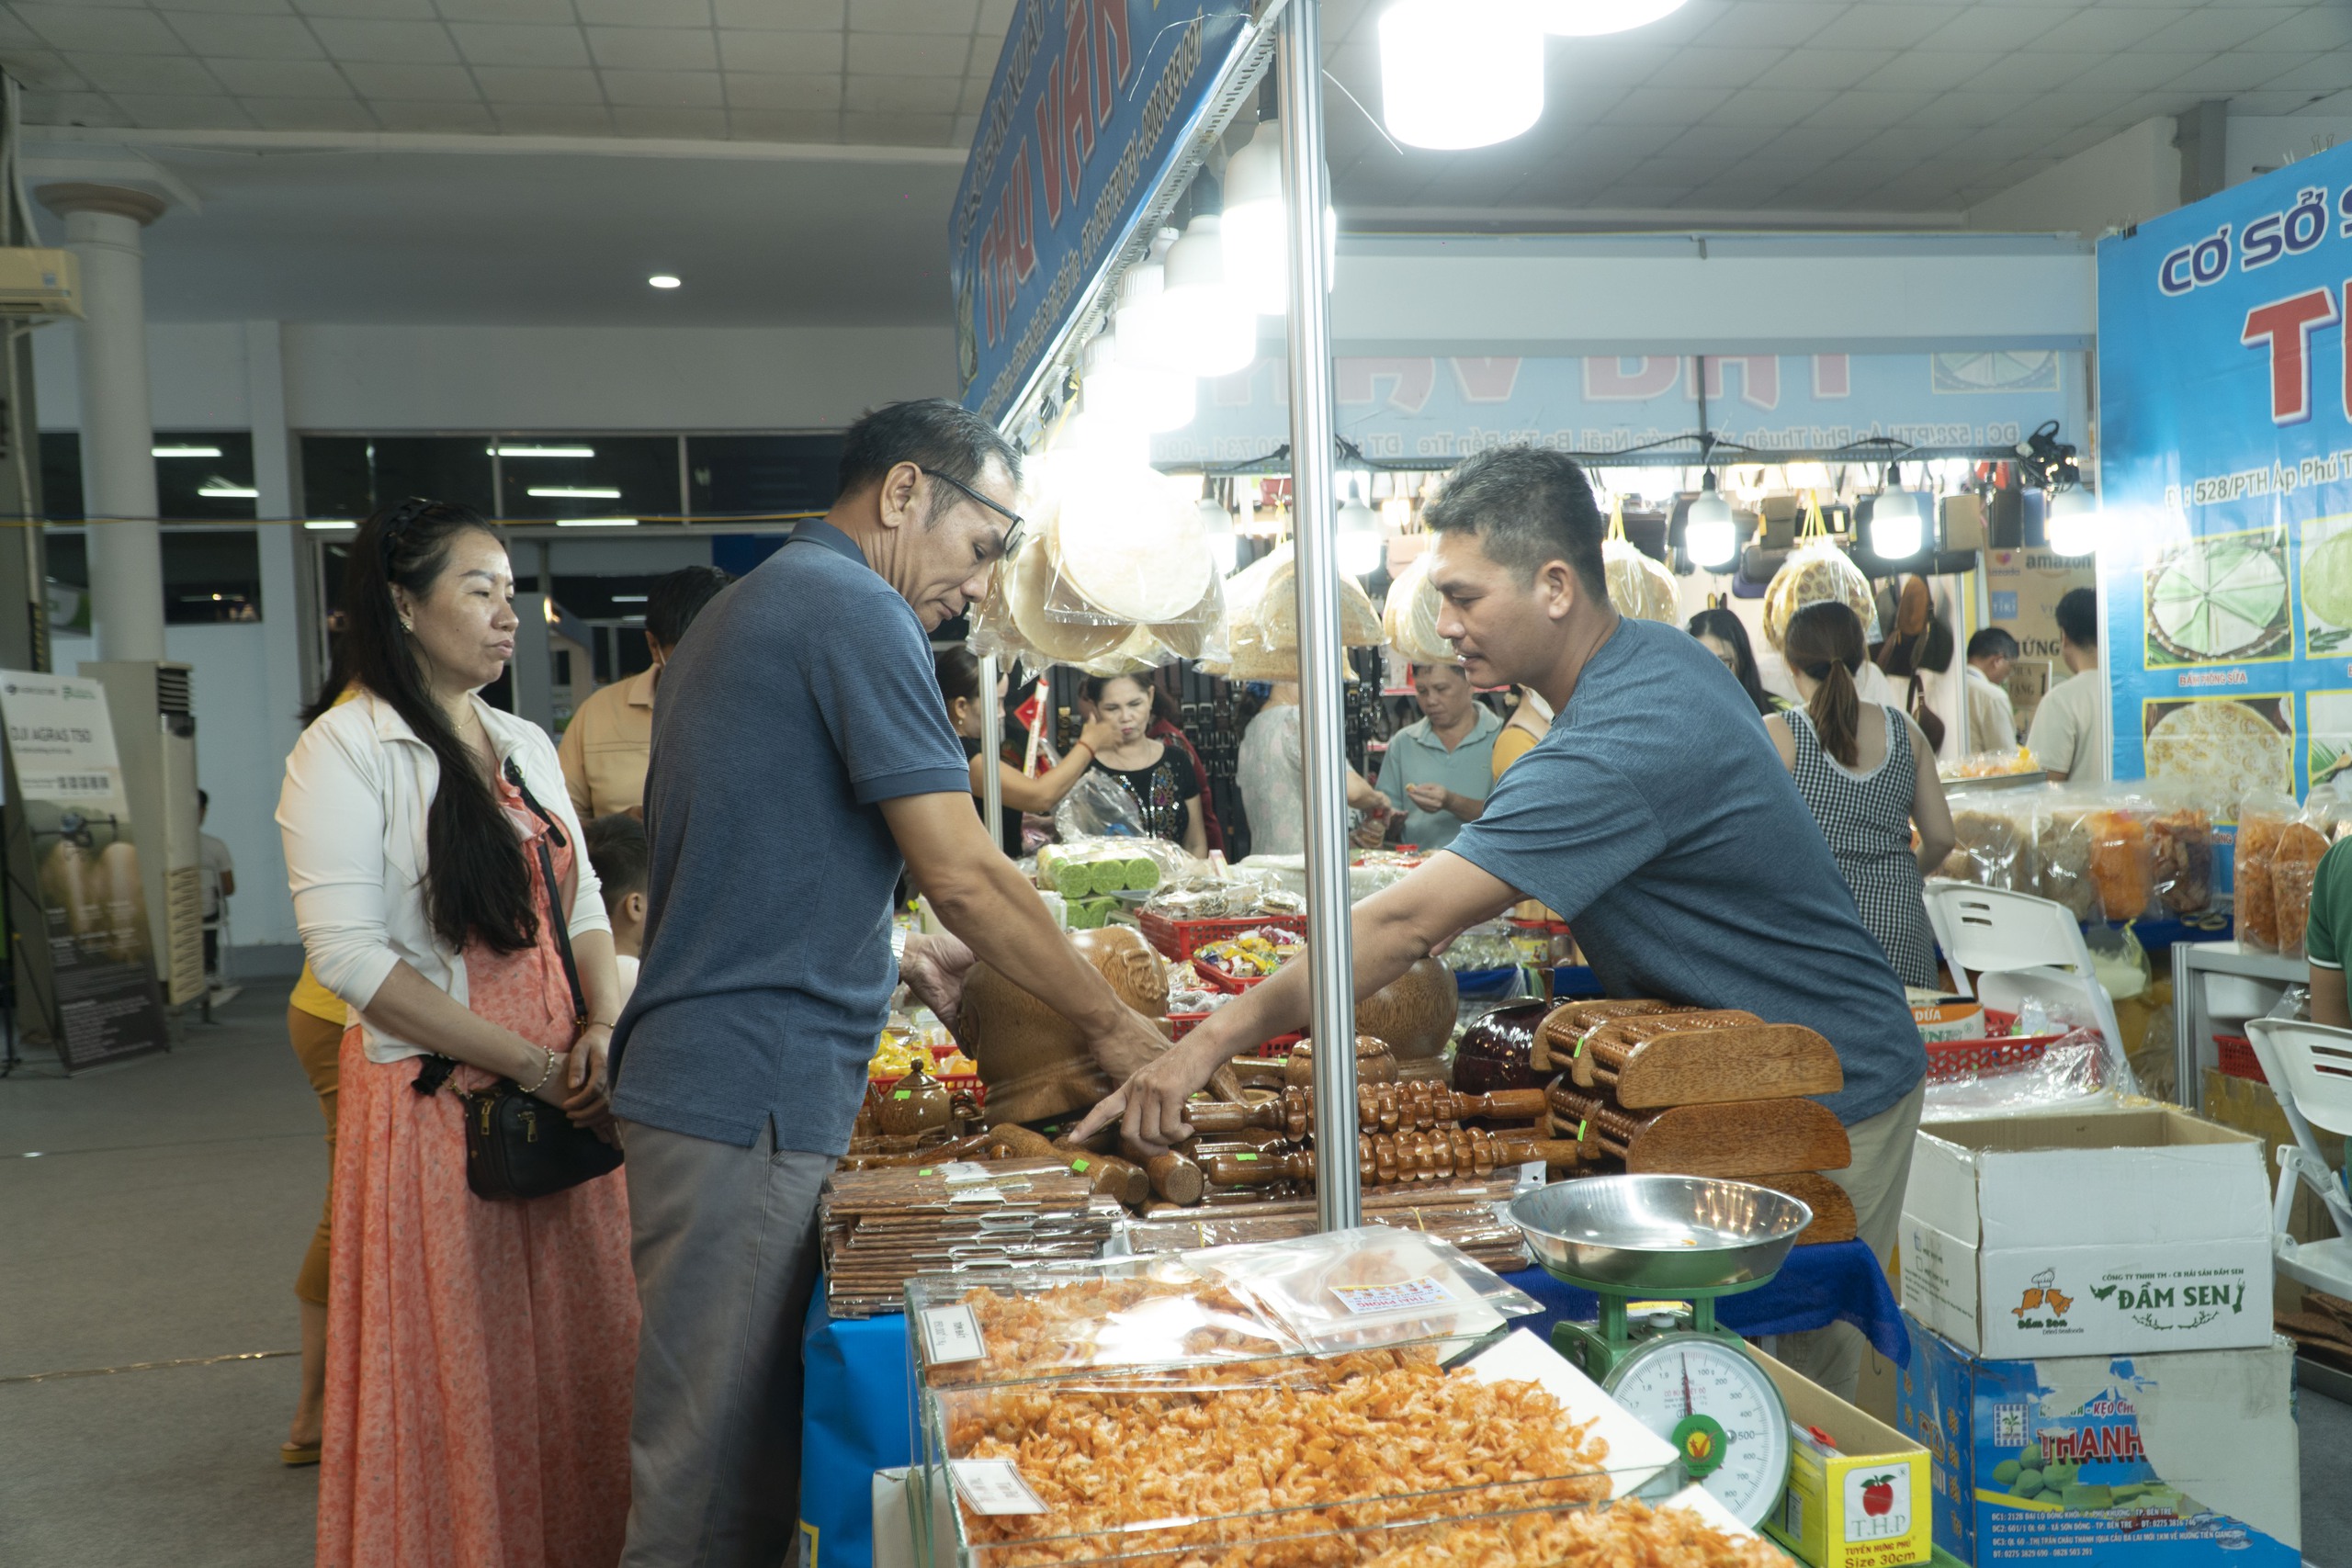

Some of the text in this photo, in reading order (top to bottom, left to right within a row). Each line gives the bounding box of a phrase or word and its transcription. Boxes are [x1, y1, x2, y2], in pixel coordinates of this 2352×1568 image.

[1162, 42, 1182, 121] 835
[2161, 225, 2232, 295] CƠ
[2241, 187, 2327, 271] SỞ
[2194, 465, 2269, 503] 528/PTH
[2300, 455, 2338, 485] Phú
[2025, 555, 2092, 570] amazon
[2118, 1281, 2231, 1310] ĐẦM SEN
[2094, 1401, 2113, 1417] KẸO
[1737, 1431, 1756, 1439] 500
[2037, 1426, 2144, 1460] THANH
[1724, 1490, 1737, 1498] 800
[1845, 1551, 1916, 1568] Size 30cm
